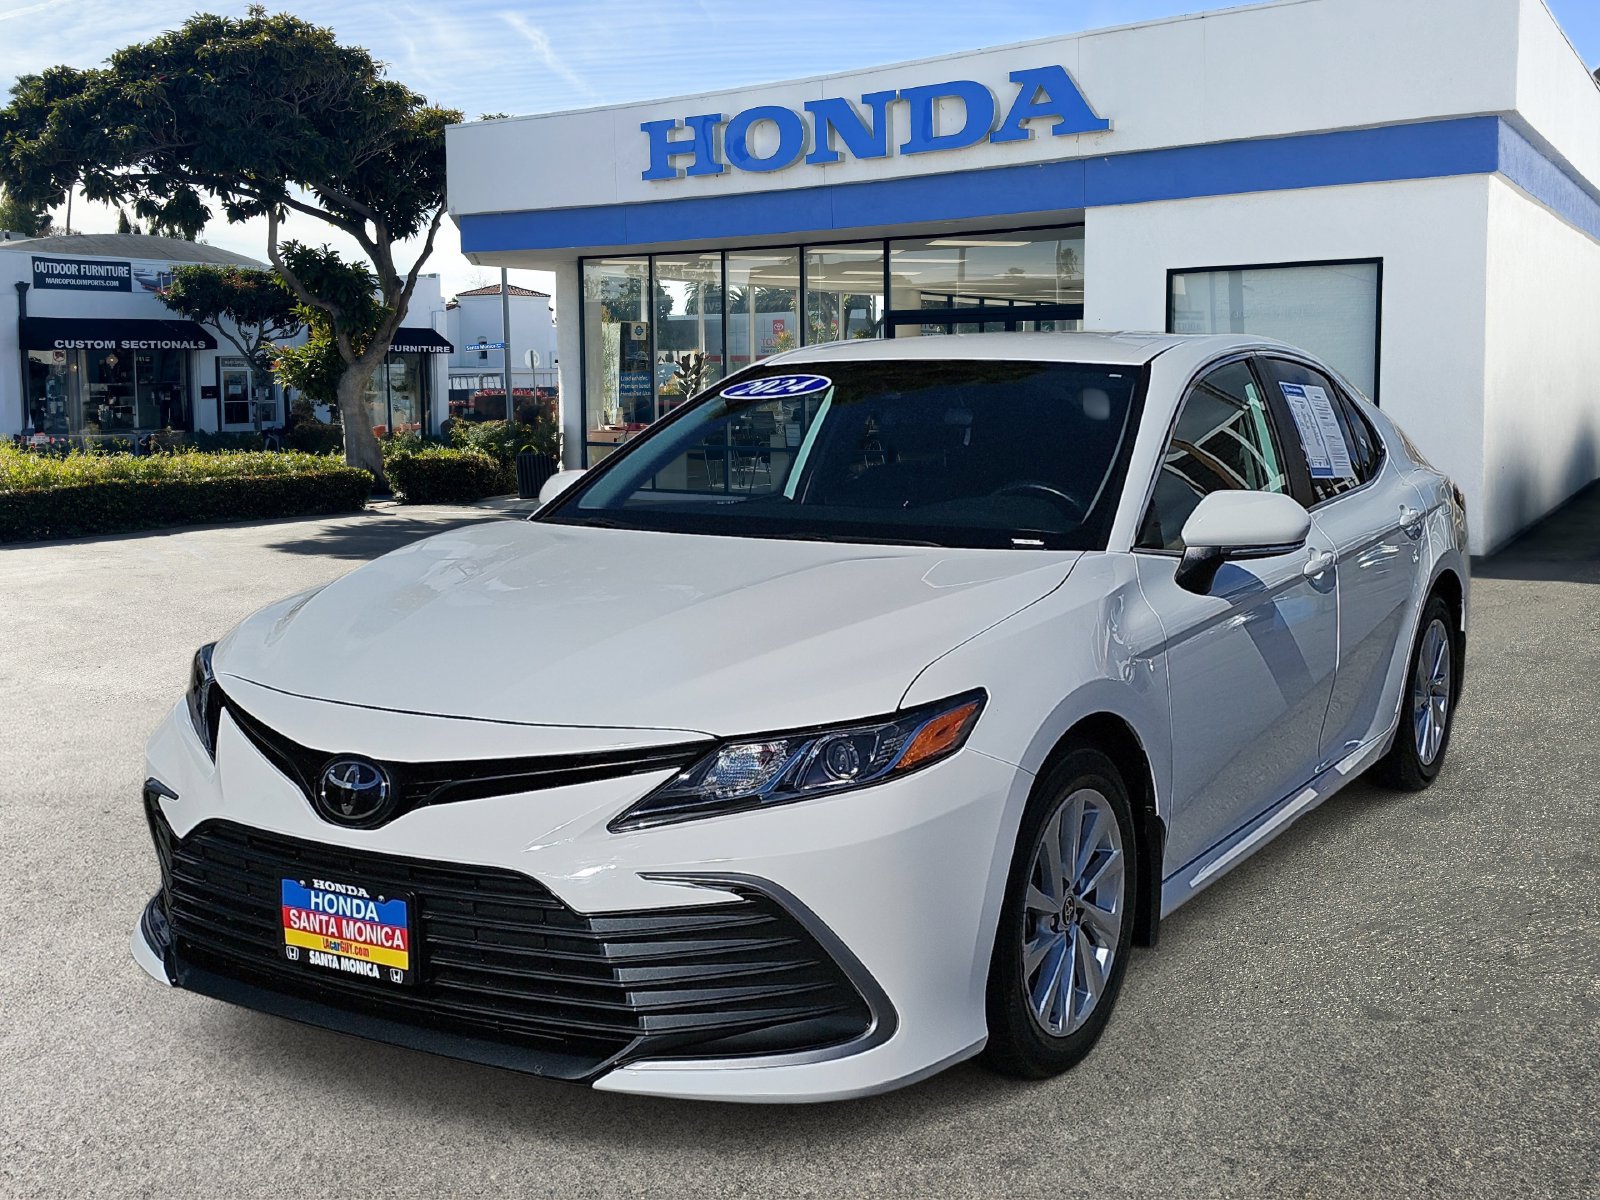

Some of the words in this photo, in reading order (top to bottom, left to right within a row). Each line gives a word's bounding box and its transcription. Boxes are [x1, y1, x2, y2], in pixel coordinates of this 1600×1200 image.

[640, 64, 1112, 181] HONDA
[34, 261, 78, 275] OUTDOOR
[80, 264, 130, 278] FURNITURE
[45, 277, 119, 287] MARCOPOLOIMPORTS.COM
[54, 339, 116, 349] CUSTOM
[121, 340, 206, 349] SECTIONALS
[388, 344, 451, 353] FURNITURE
[729, 376, 821, 396] 2024
[312, 879, 370, 898] HONDA
[310, 890, 380, 922] HONDA
[289, 910, 339, 937] SANTA
[342, 919, 405, 950] MONICA
[309, 950, 340, 969] SANTA
[341, 956, 380, 979] MONICA
